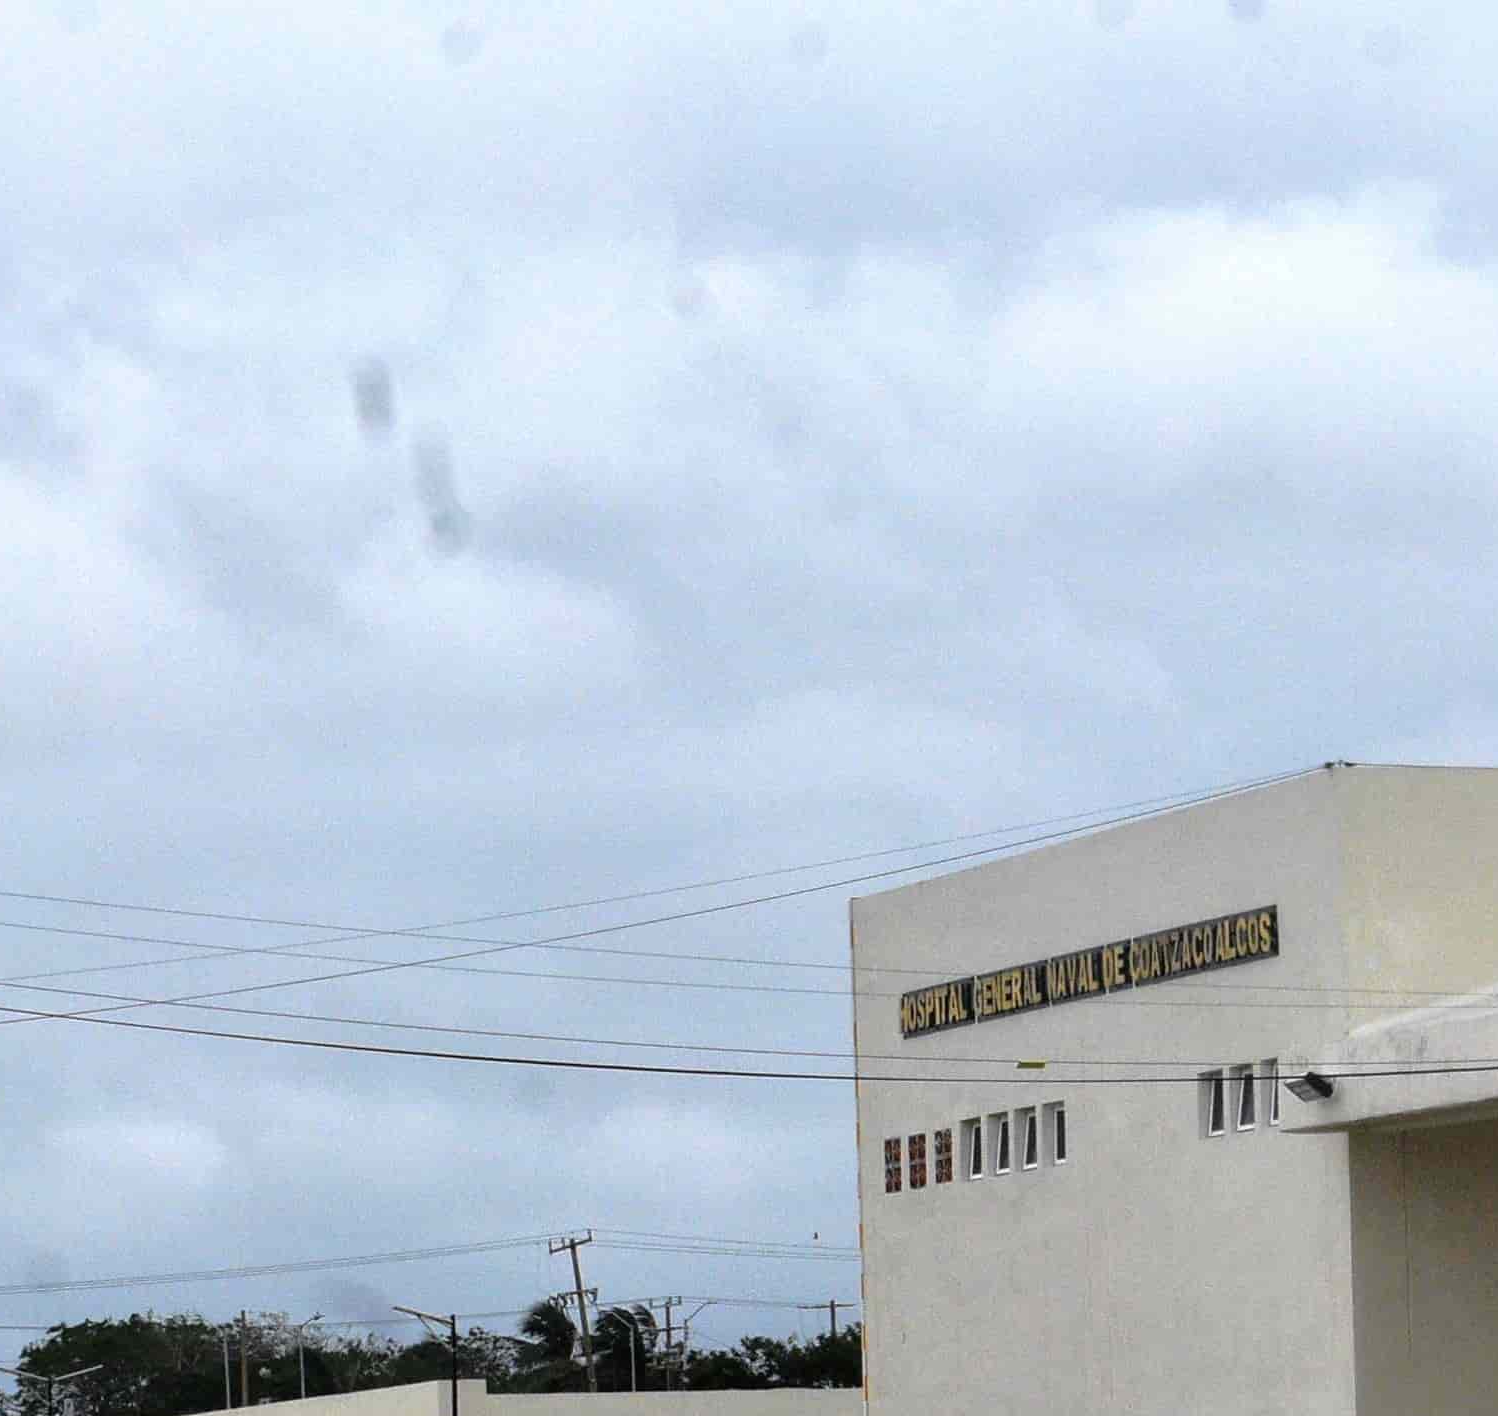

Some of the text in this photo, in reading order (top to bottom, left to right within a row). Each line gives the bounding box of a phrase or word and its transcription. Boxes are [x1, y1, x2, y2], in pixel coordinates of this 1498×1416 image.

[901, 912, 1271, 1033] HOSPITAL GENERAL NAVAL DE COATZACOALCOS
